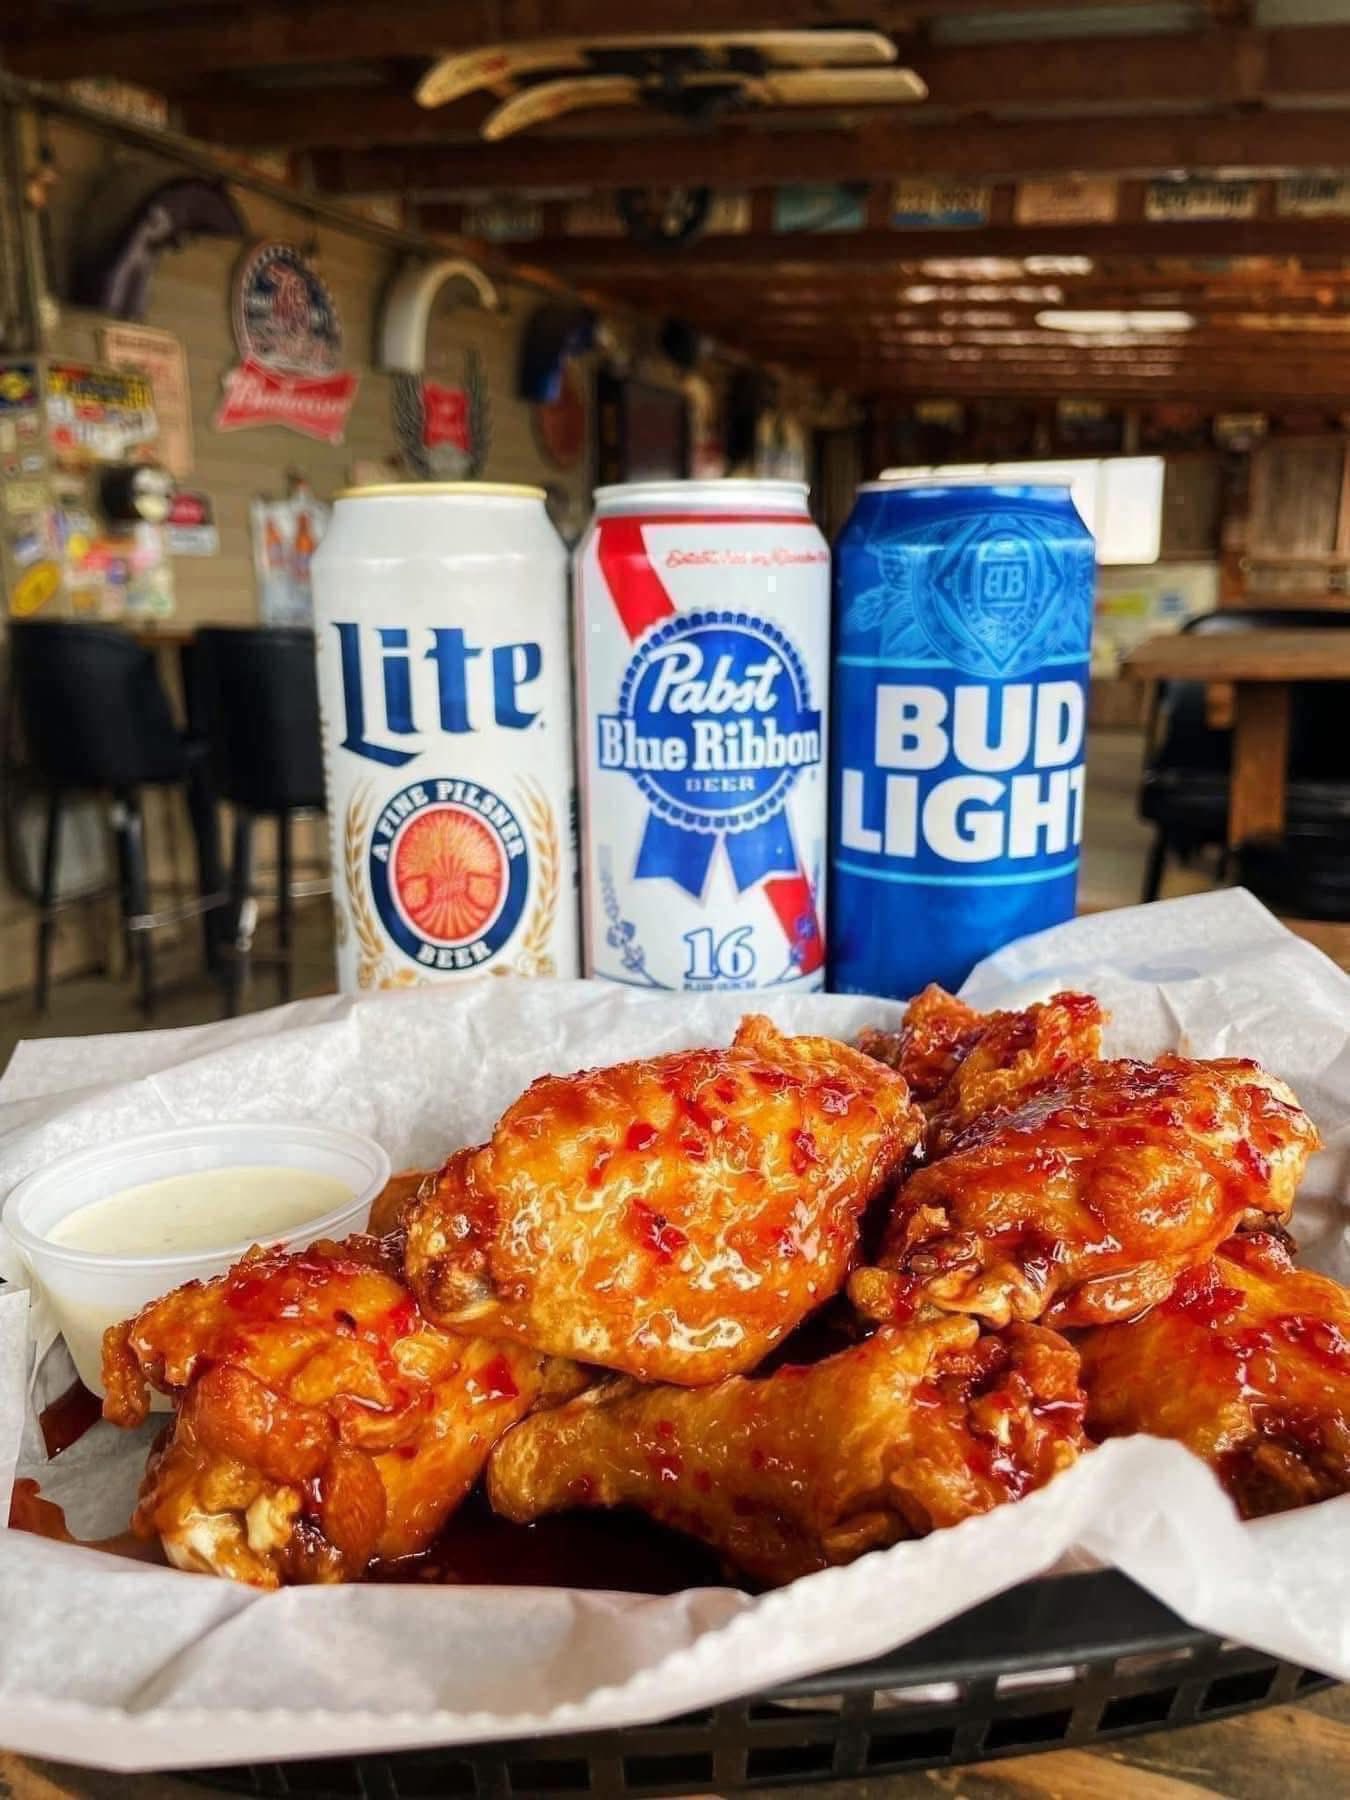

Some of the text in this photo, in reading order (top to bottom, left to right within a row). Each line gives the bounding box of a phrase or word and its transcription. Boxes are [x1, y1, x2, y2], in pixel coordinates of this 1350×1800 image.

[331, 622, 543, 767] Lite
[646, 641, 783, 714] Pabst
[600, 718, 820, 772] Blue Ribbon
[875, 681, 1085, 772] BUD
[685, 777, 756, 792] BEER
[372, 843, 390, 864] A
[382, 785, 429, 841] FINE
[435, 779, 526, 859] PILSNER
[416, 940, 492, 969] BEER
[683, 925, 756, 981] 16
